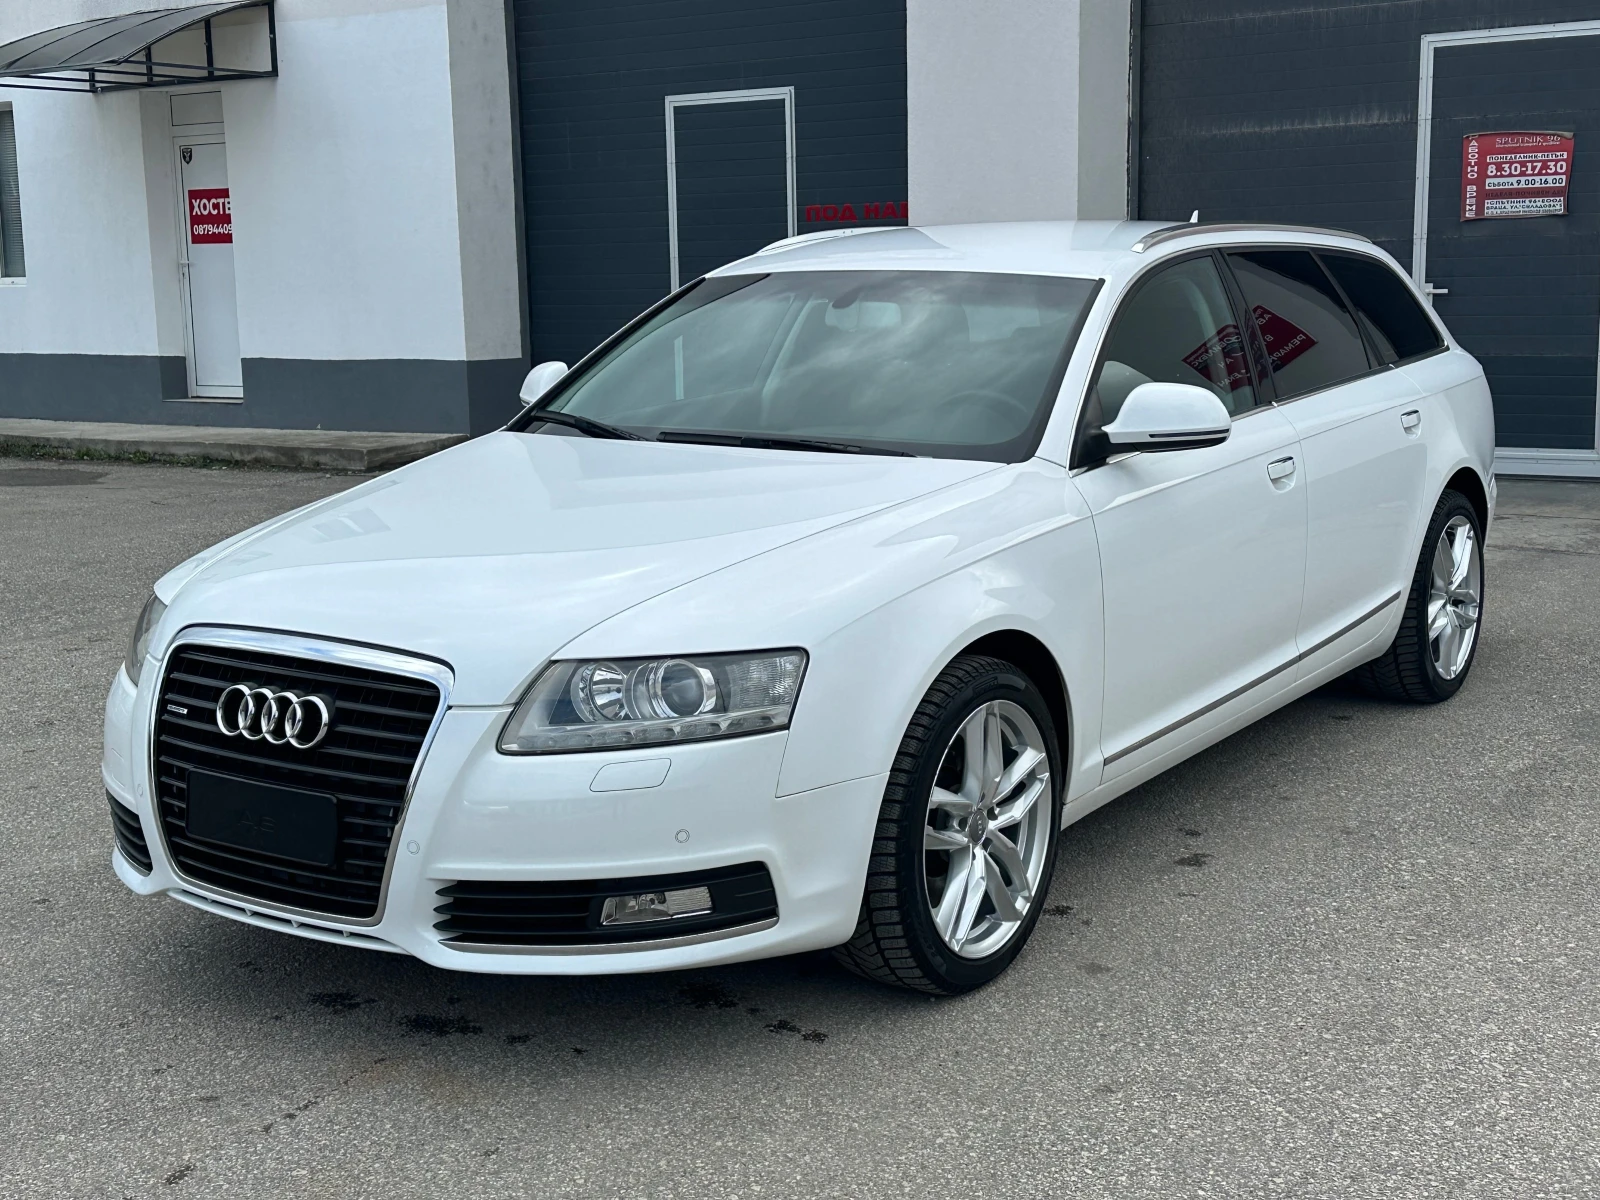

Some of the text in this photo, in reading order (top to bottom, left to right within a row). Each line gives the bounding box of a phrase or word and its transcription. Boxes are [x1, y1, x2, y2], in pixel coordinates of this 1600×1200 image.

[1496, 136, 1543, 144] SPUTNIK
[1487, 161, 1567, 176] 8.30-17.30
[1516, 177, 1564, 187] 9.00-16.00
[805, 203, 858, 223] ПОД
